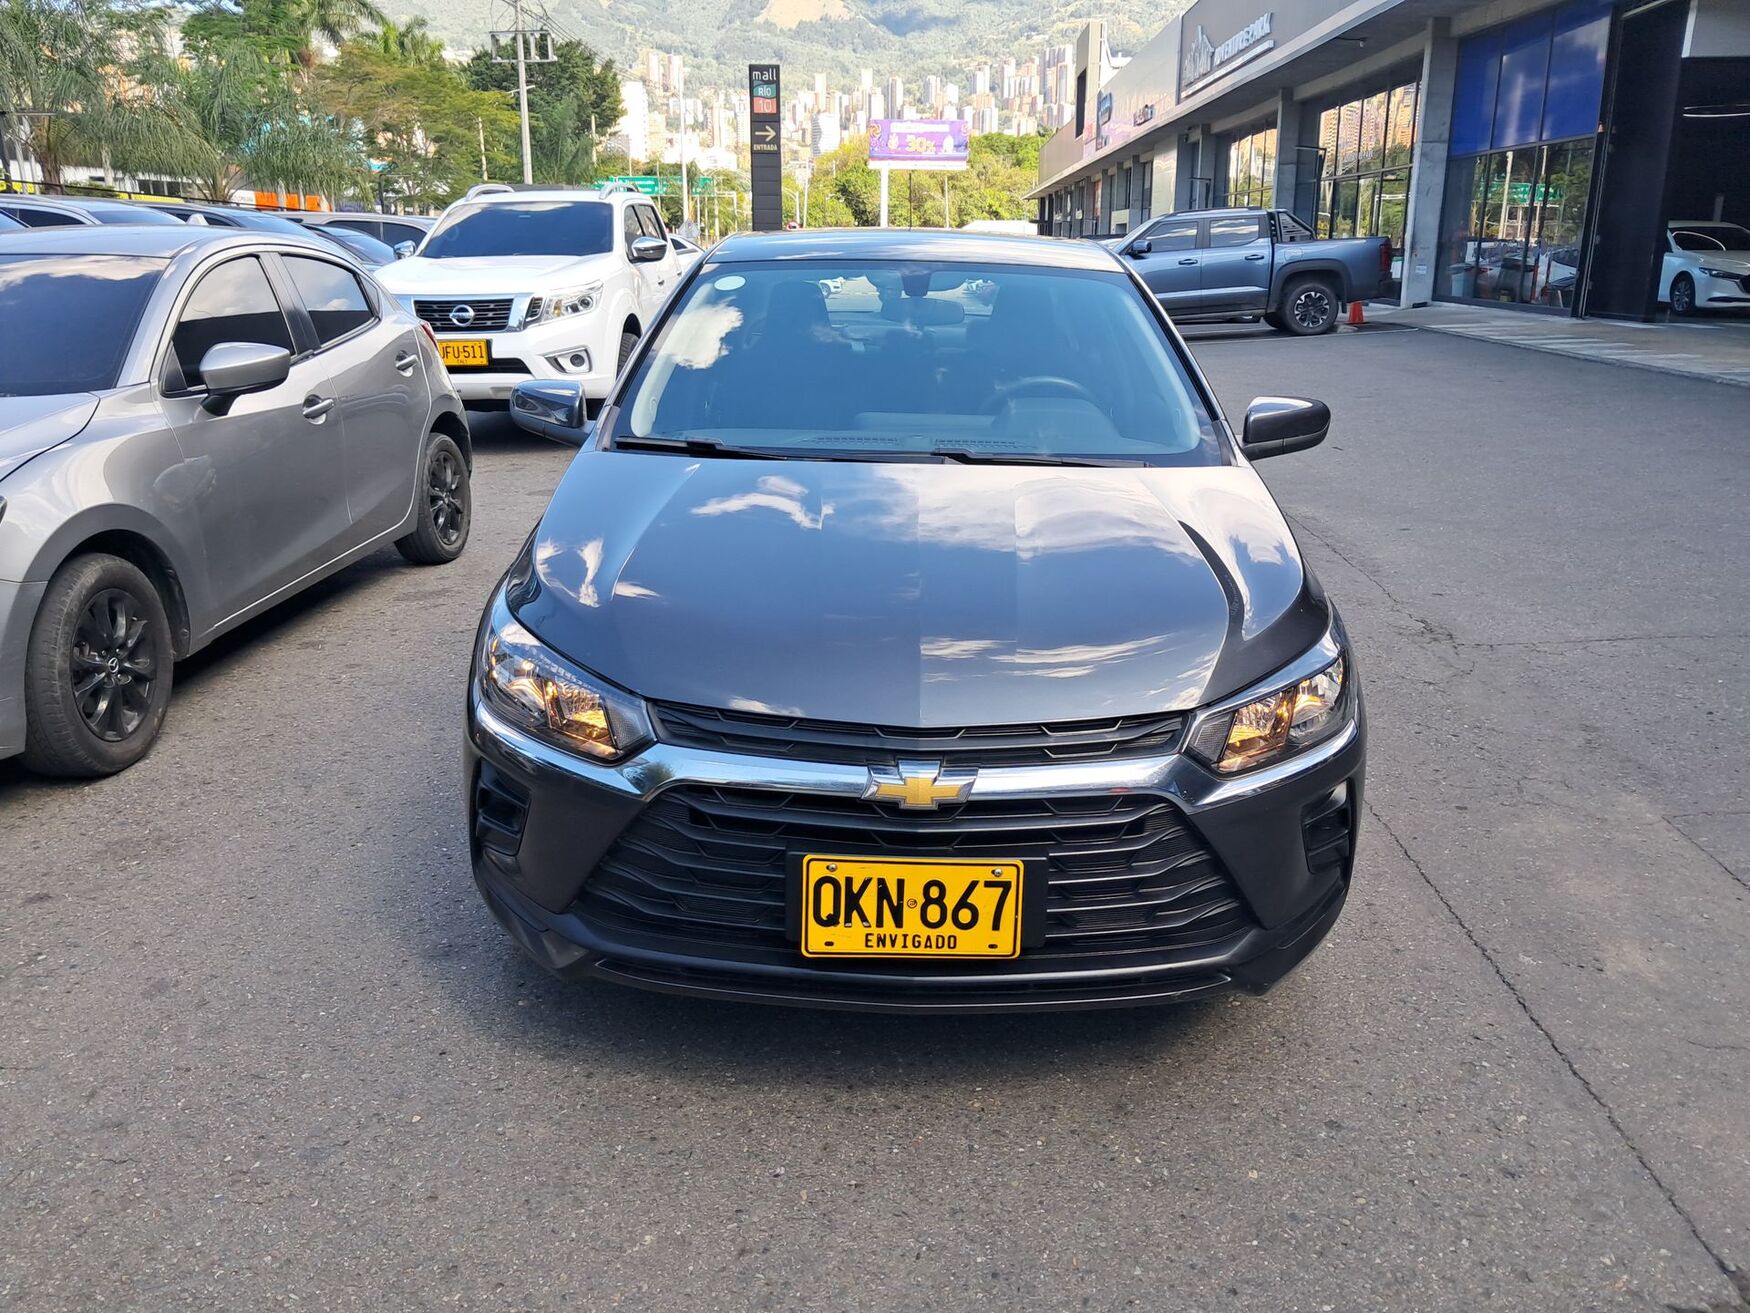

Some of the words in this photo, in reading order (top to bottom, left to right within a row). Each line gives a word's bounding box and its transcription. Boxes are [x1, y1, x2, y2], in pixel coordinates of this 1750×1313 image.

[752, 68, 777, 80] mall
[759, 100, 772, 112] 10
[753, 143, 778, 151] ENTRADA
[812, 875, 906, 928] QKN
[919, 879, 1013, 931] 867
[864, 932, 958, 950] ENVIGADO
